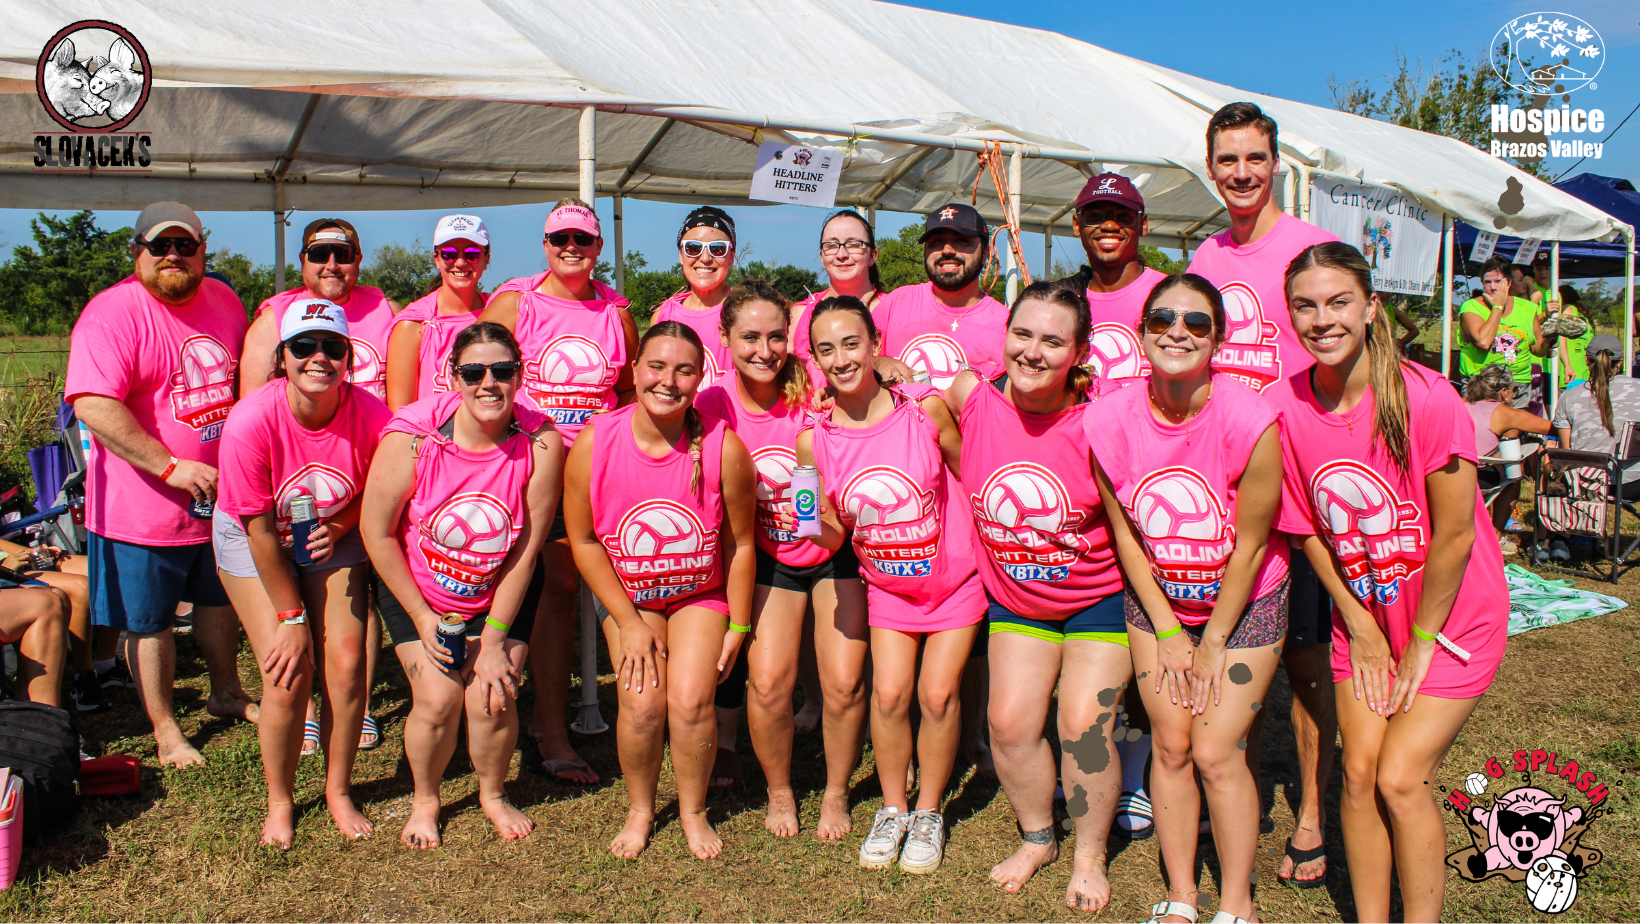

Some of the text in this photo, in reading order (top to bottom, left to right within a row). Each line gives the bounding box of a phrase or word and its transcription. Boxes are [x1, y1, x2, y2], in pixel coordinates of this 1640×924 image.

[773, 167, 824, 183] HEADLINE
[775, 180, 818, 193] HITTERS
[1330, 184, 1429, 221] Cancer Clinic
[305, 303, 330, 315] WT
[1212, 348, 1273, 368] ADLINE
[177, 385, 233, 410] HEADLIN
[540, 396, 602, 407] HITTERS
[191, 405, 232, 427] HITTE
[201, 423, 223, 441] KBT
[768, 528, 793, 542] KB
[980, 521, 1080, 548] HEADLE
[864, 544, 936, 558] HITTERS
[994, 549, 1075, 563] HITTERS
[1150, 536, 1234, 562] ADLINE
[1334, 535, 1417, 560] ADLINE
[431, 558, 496, 583] HITTER
[626, 573, 708, 589] HITTERS
[1161, 581, 1202, 599] BTX
[1349, 576, 1385, 603] KBX
